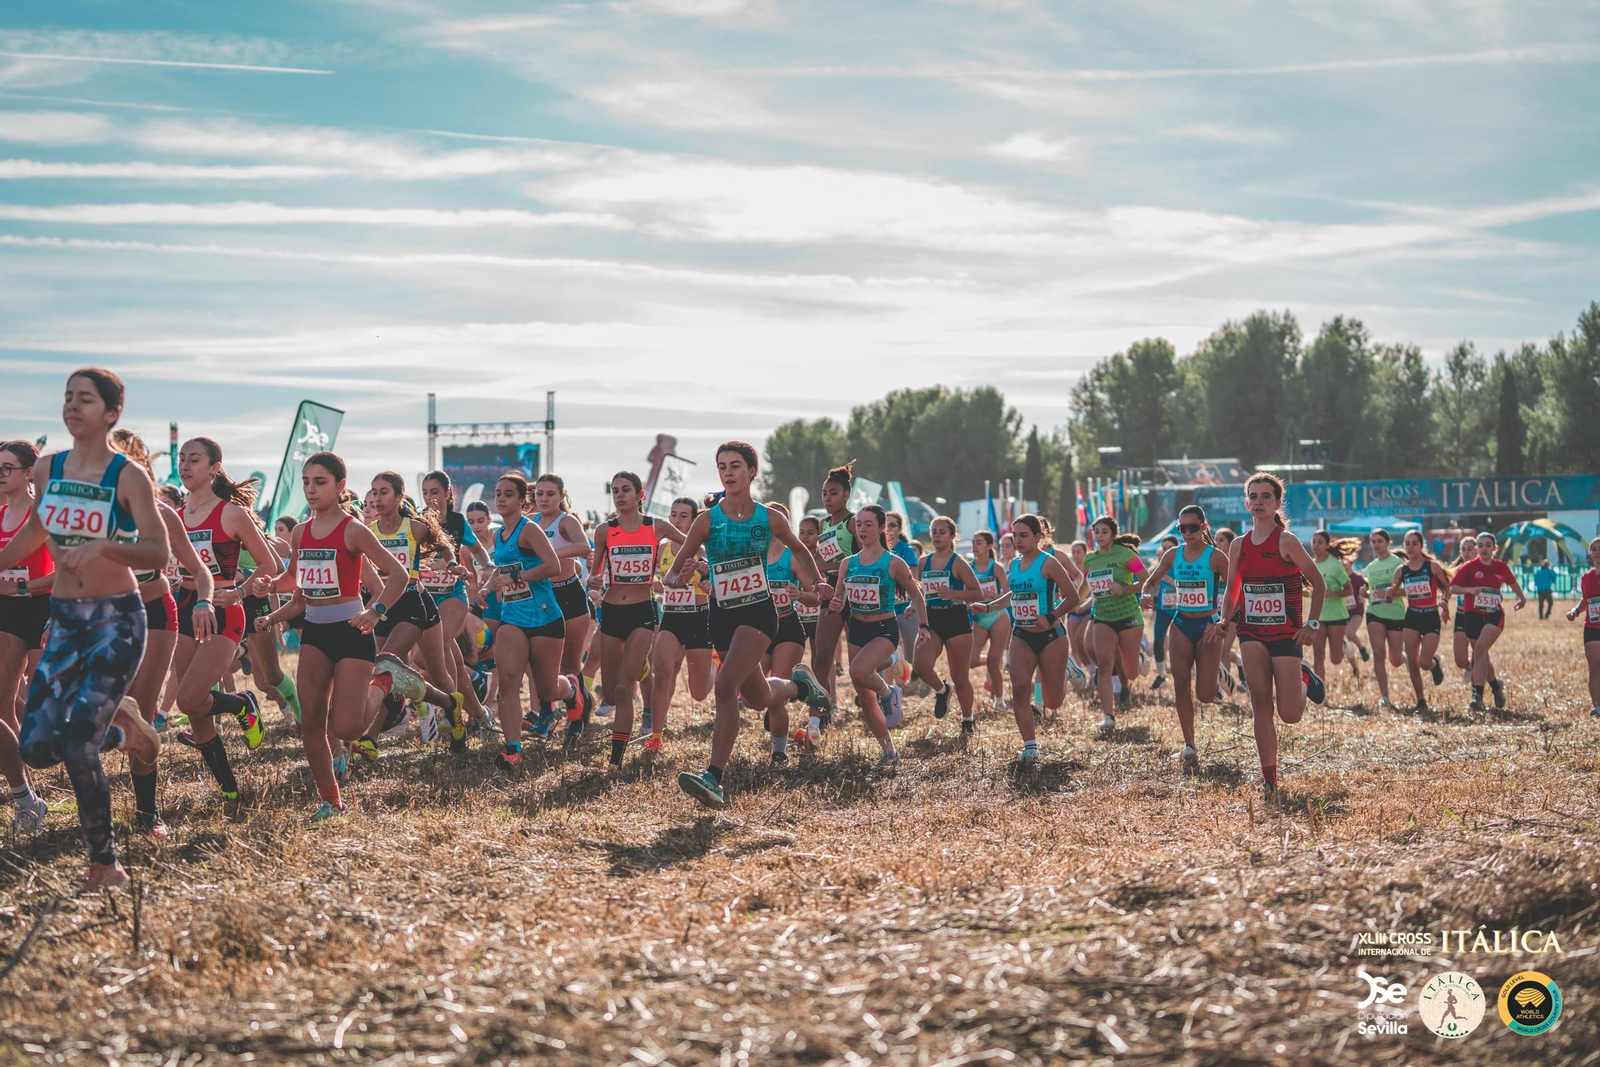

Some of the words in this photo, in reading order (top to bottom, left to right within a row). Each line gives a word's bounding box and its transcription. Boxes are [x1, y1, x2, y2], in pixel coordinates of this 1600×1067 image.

[1308, 486, 1368, 509] XLIII
[1369, 484, 1419, 499] CROSS
[1442, 476, 1563, 508] ITÁLICA
[45, 505, 103, 533] 7430
[615, 560, 650, 573] 7458
[1178, 569, 1200, 577] nerja
[299, 568, 334, 584] 7411
[719, 573, 763, 597] 7423
[1010, 581, 1033, 589] nerja
[665, 591, 692, 603] 7477
[848, 588, 877, 601] 7422
[1178, 592, 1205, 604] 7490
[1477, 595, 1499, 606] 5530
[1248, 600, 1282, 613] 7409
